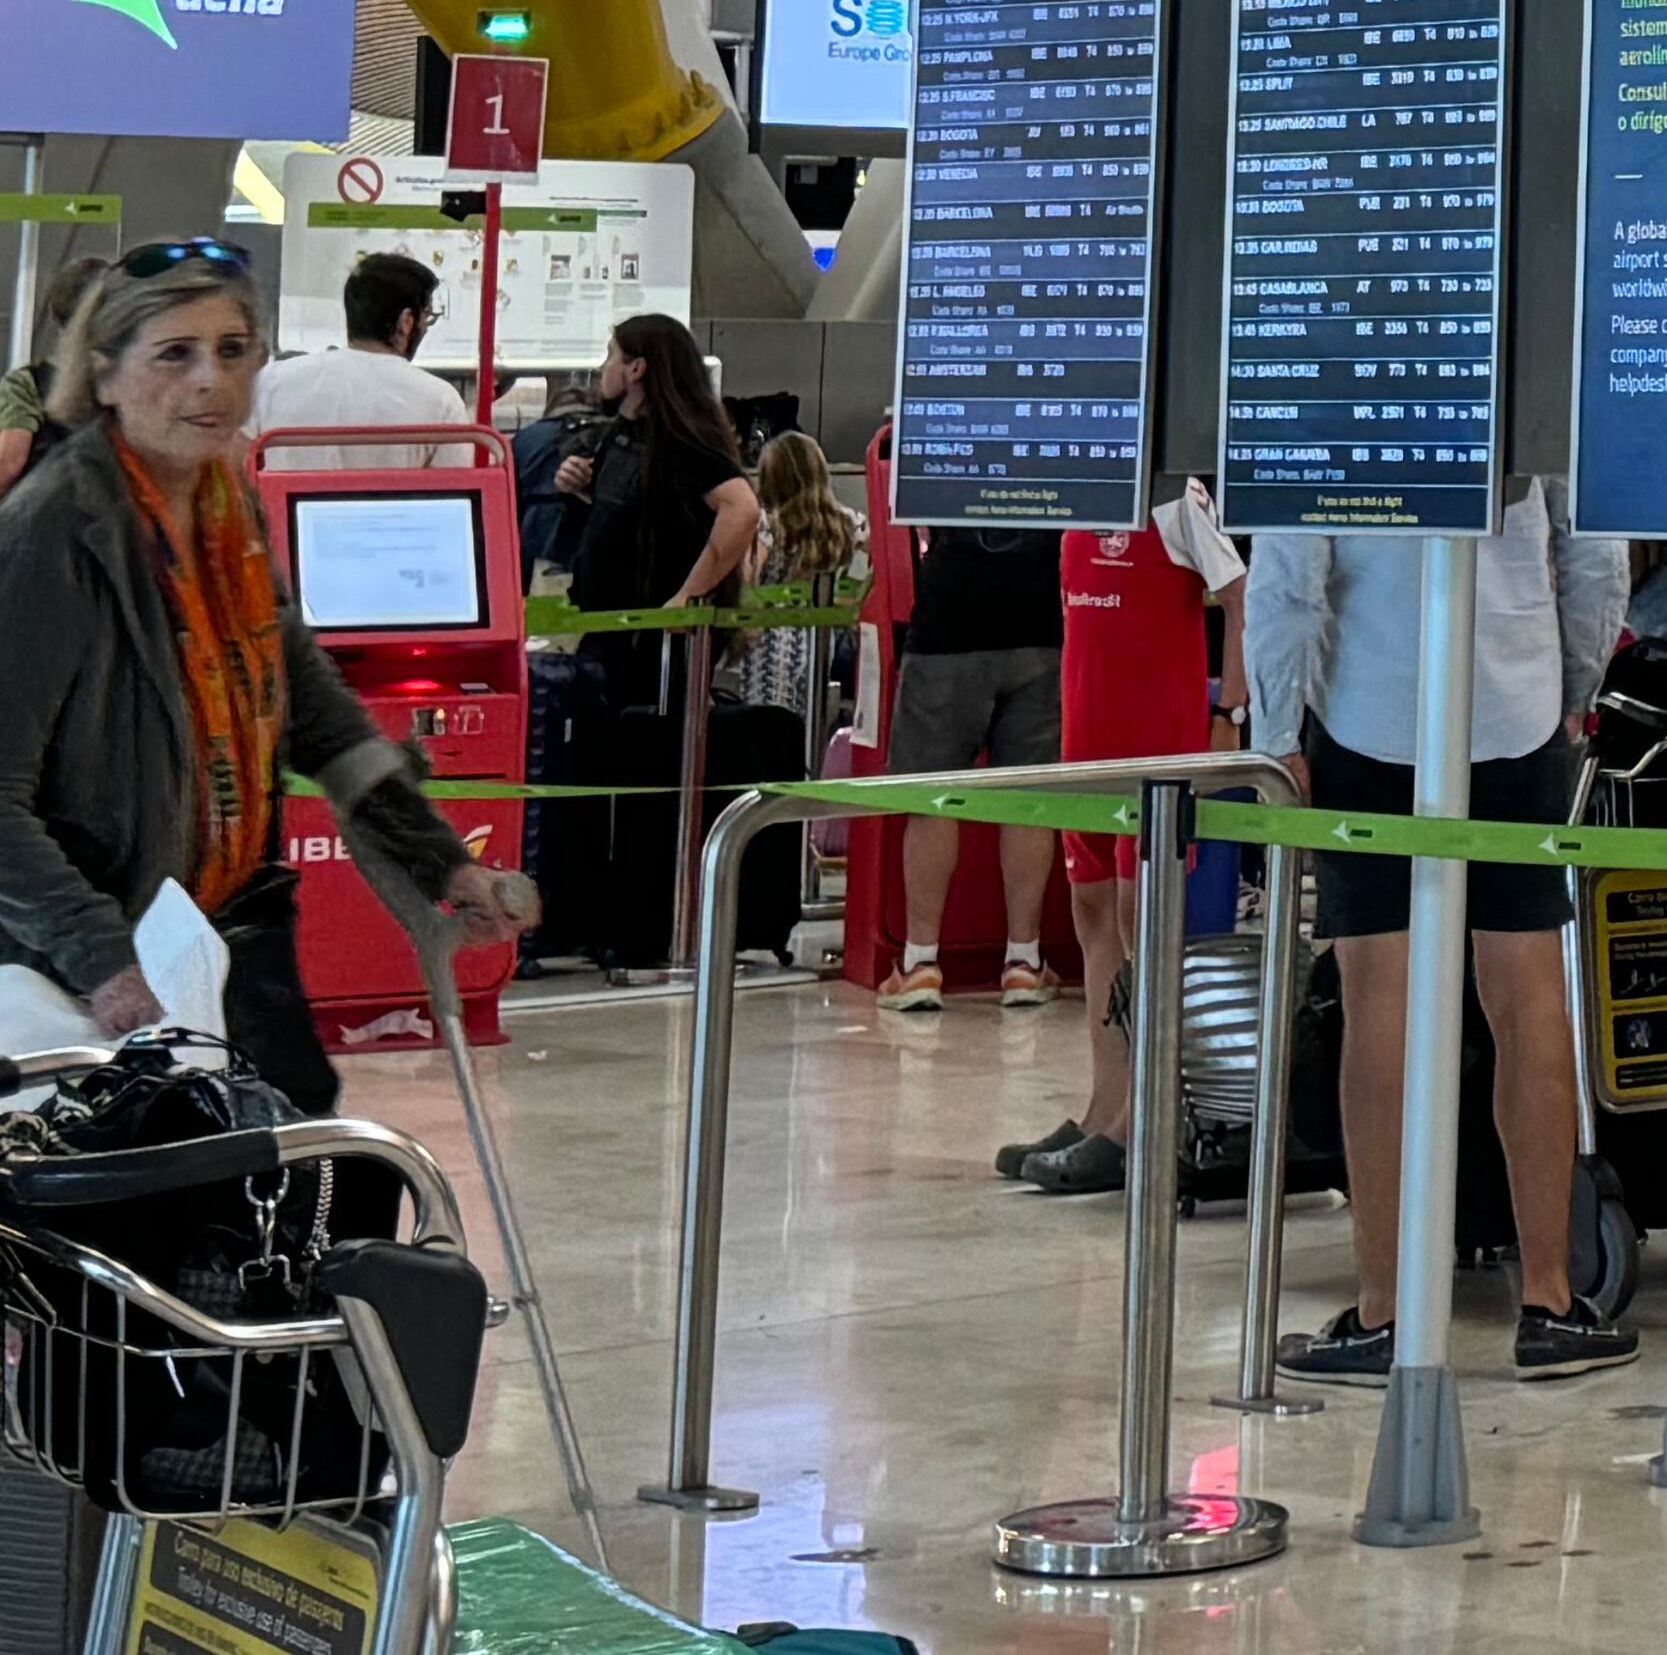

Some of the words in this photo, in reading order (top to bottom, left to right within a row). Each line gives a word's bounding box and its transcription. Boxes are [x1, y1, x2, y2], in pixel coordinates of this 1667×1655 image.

[828, 41, 881, 62] Europe
[484, 94, 510, 135] 1
[1618, 116, 1628, 131] o
[1614, 221, 1624, 240] A
[1613, 250, 1660, 272] airport
[1610, 315, 1658, 334] Please
